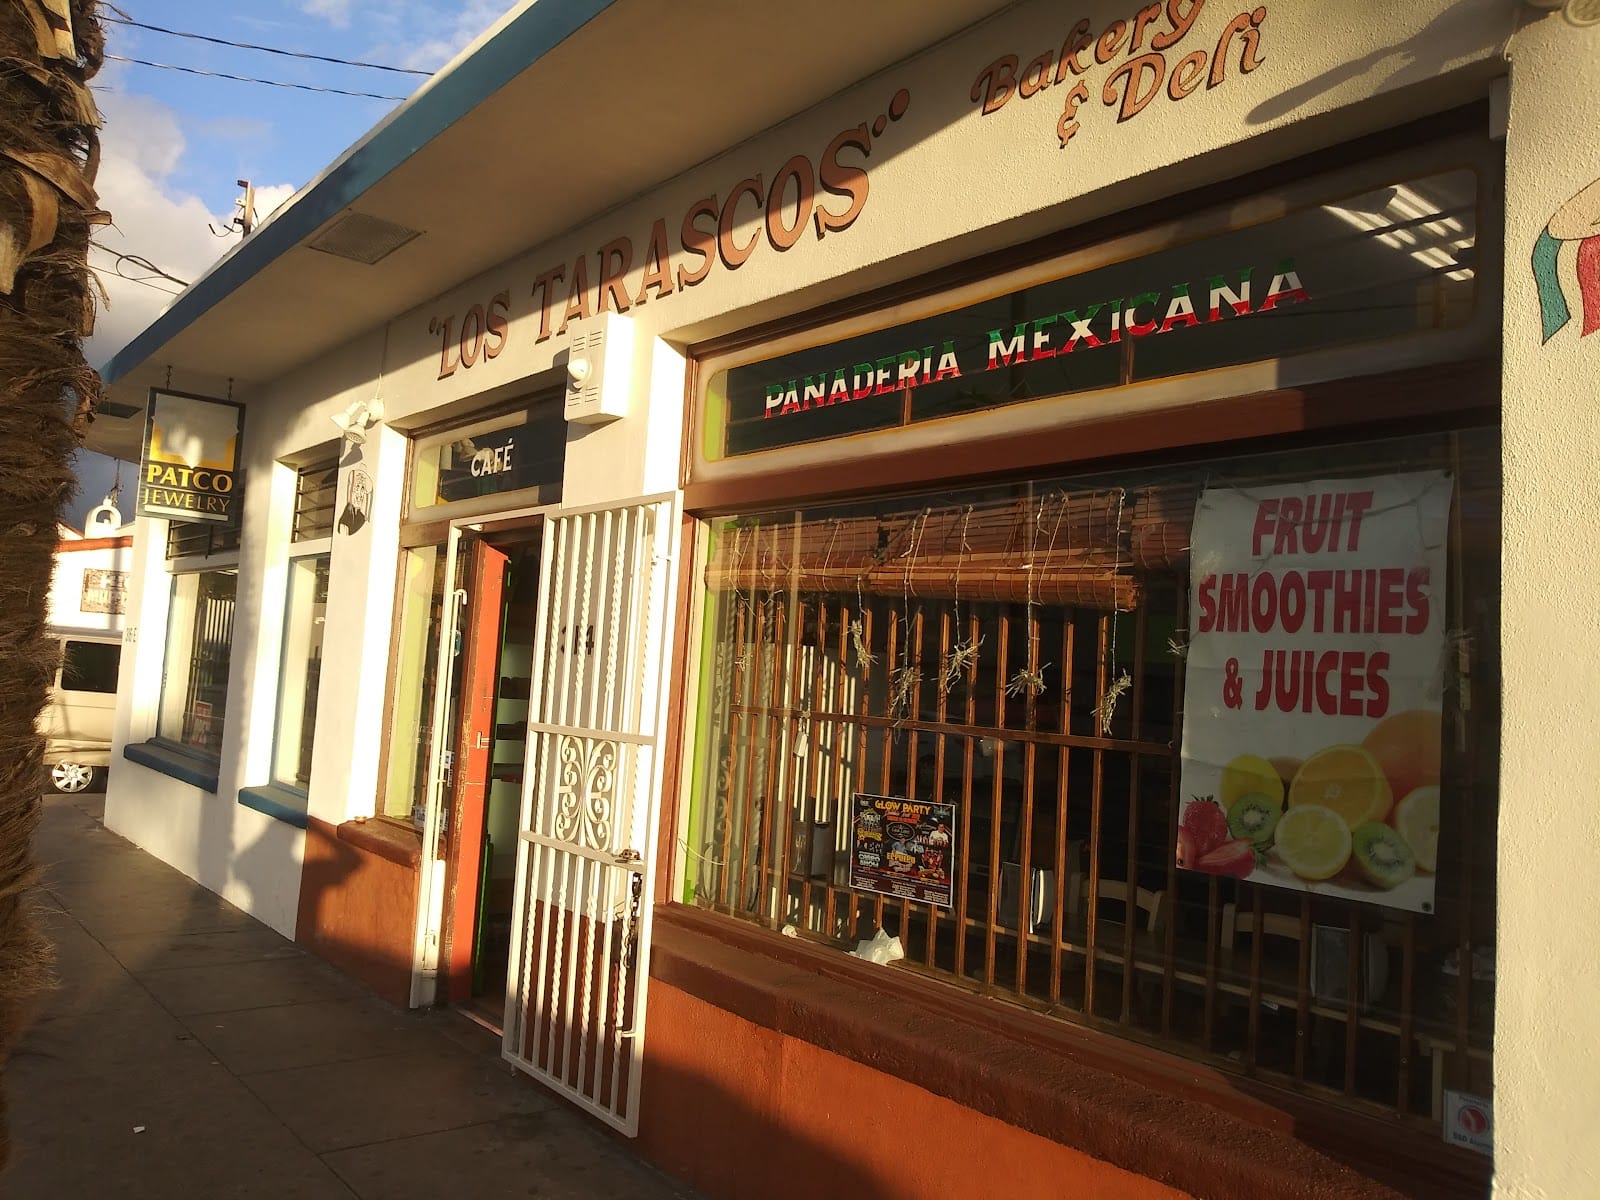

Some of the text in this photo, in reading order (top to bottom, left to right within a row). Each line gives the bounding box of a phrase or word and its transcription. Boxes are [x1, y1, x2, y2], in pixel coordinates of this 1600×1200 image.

[970, 0, 1203, 116] Bakery
[1057, 6, 1267, 149] & Deli
[763, 257, 1313, 420] PANADERIA MEXICANA
[146, 463, 233, 493] PATCO
[471, 437, 515, 477] CAFÉ
[142, 488, 230, 513] JEWELRY
[1252, 491, 1374, 556] FRUIT
[1198, 567, 1431, 635] SMOOTHIES
[561, 625, 595, 656] 14
[1223, 650, 1391, 719] & JUICES
[875, 800, 901, 811] GLOW
[903, 802, 931, 815] PARTY
